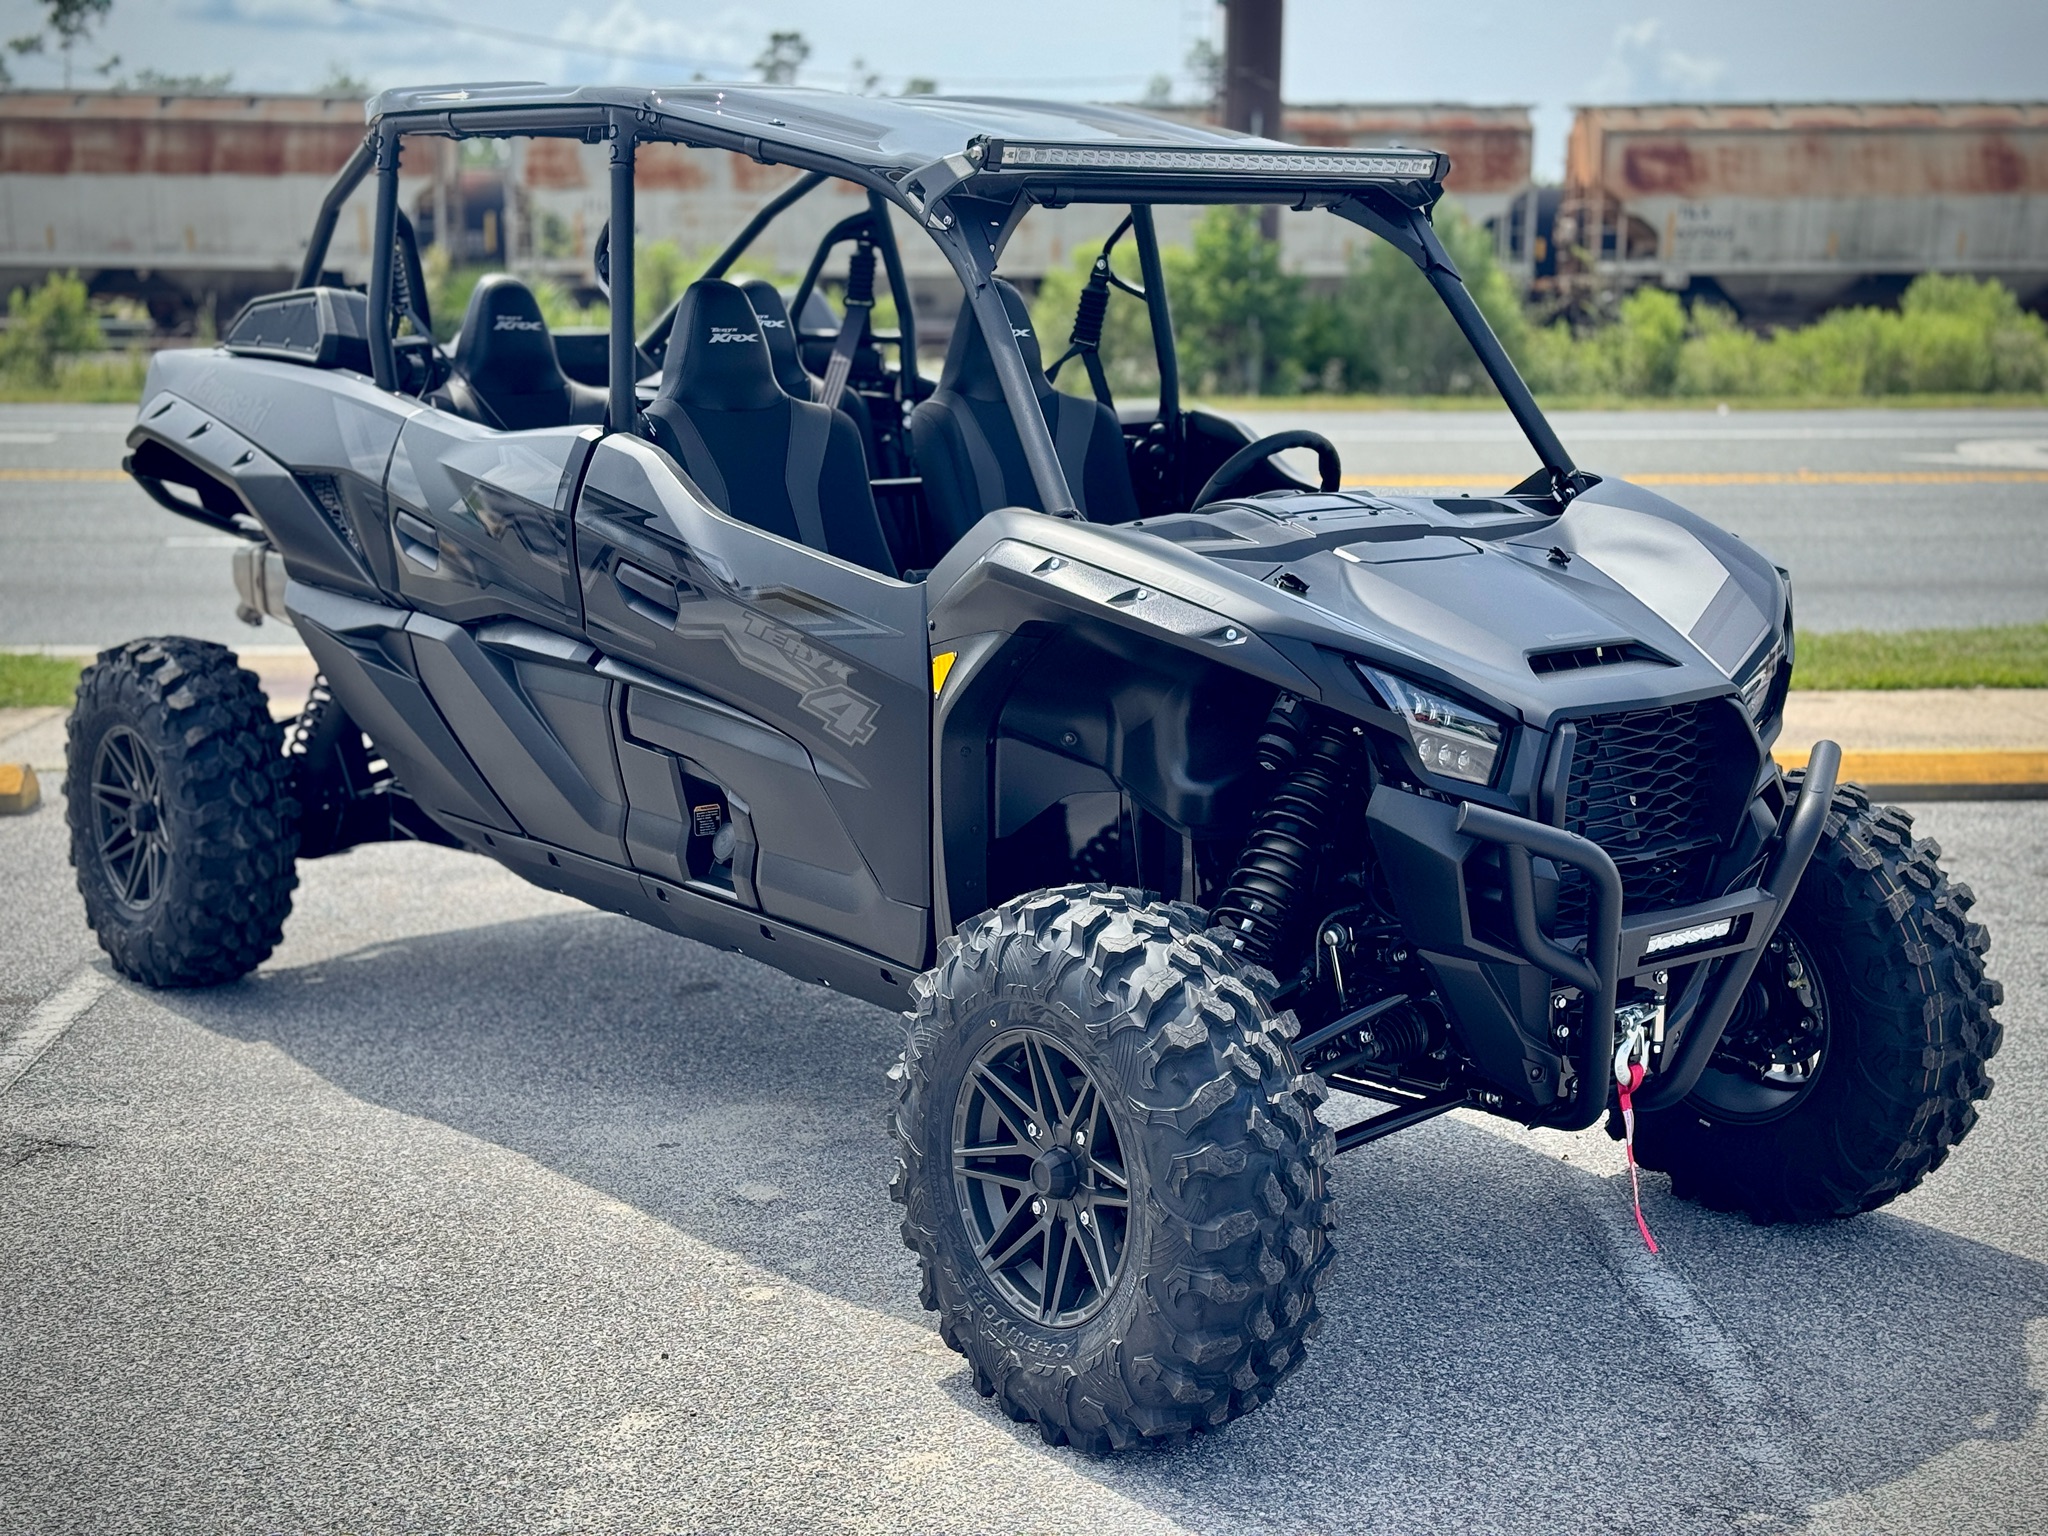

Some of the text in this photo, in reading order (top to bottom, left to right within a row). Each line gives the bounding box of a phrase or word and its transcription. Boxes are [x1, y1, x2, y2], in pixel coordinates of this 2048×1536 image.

[708, 333, 759, 344] KRX
[802, 686, 878, 742] 4
[961, 1273, 1070, 1358] CARNIVORE
